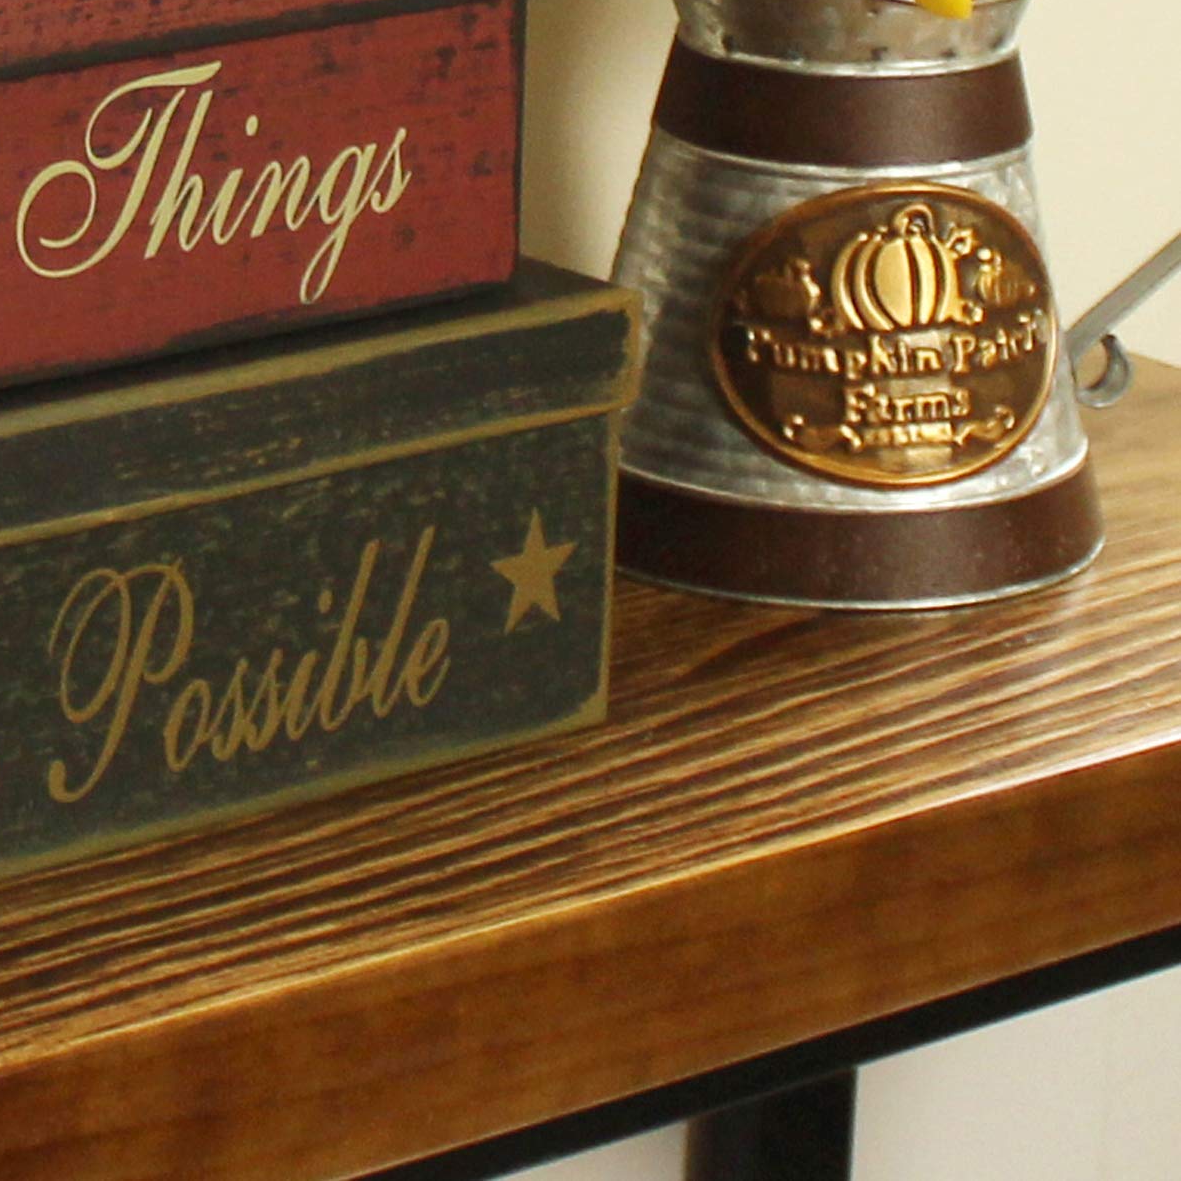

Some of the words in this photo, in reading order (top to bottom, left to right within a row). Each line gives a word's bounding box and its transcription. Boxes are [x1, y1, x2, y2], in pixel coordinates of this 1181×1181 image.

[17, 61, 412, 304] Things
[846, 382, 971, 423] Farms
[47, 526, 450, 803] Possible
